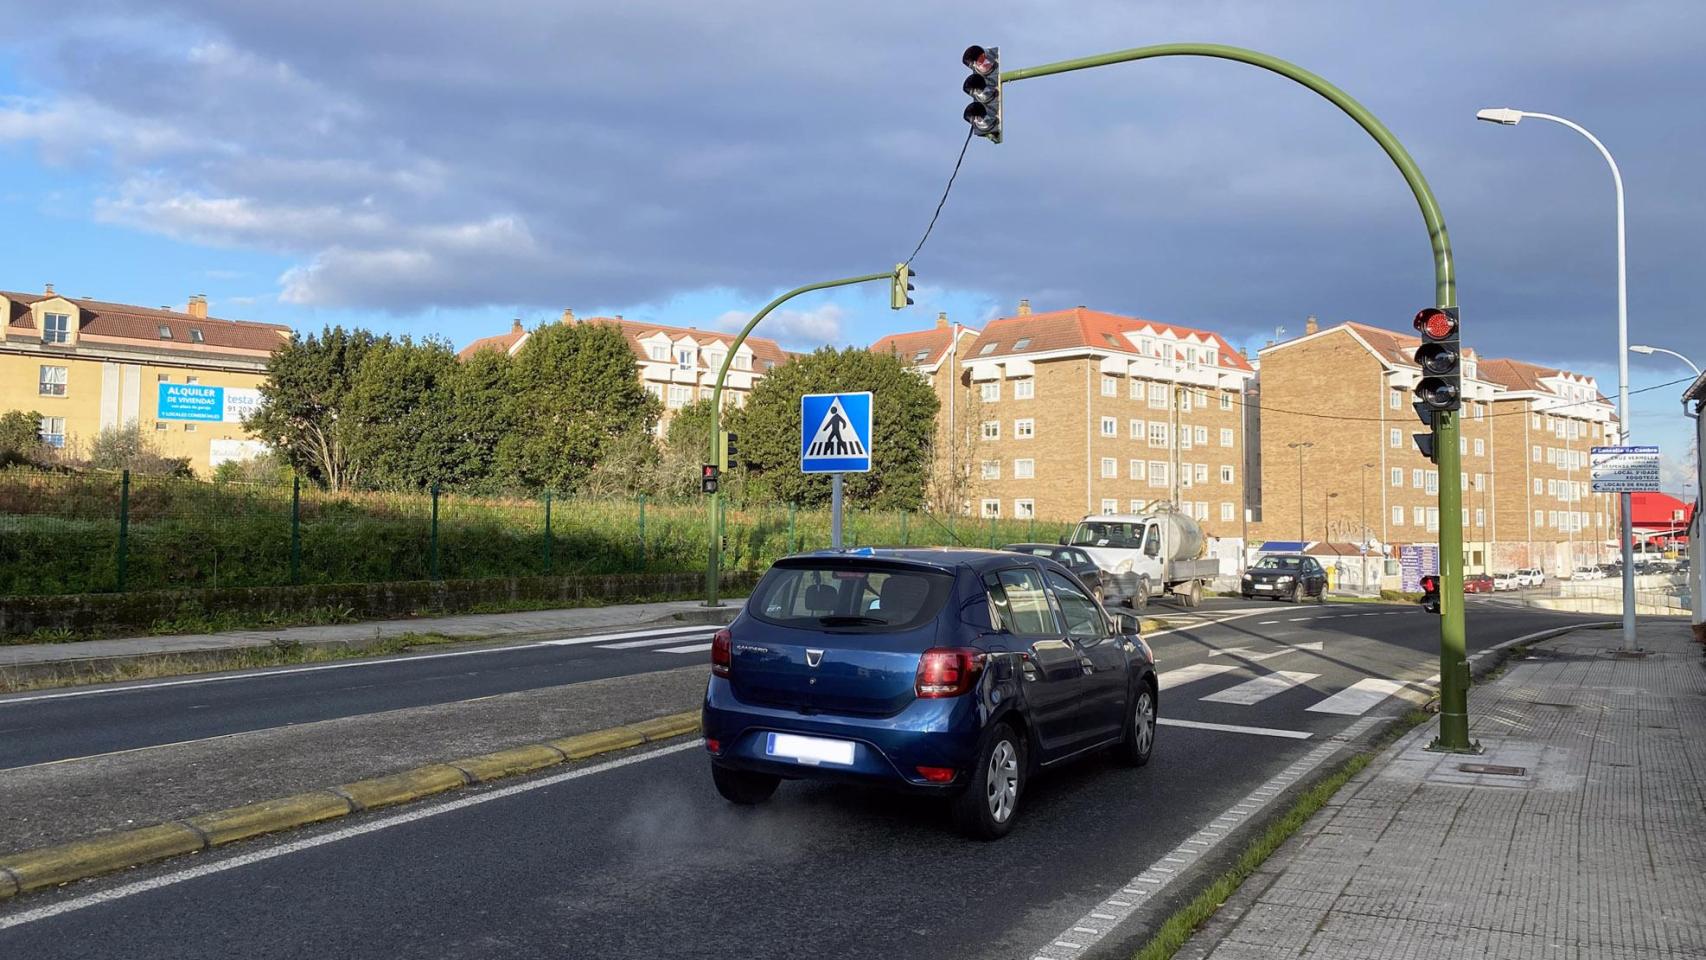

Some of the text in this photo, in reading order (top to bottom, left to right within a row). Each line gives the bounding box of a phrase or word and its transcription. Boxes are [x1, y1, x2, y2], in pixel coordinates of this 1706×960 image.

[167, 387, 215, 397] ALQUILER
[178, 397, 215, 405] VIVIENDAS
[227, 395, 253, 405] testa
